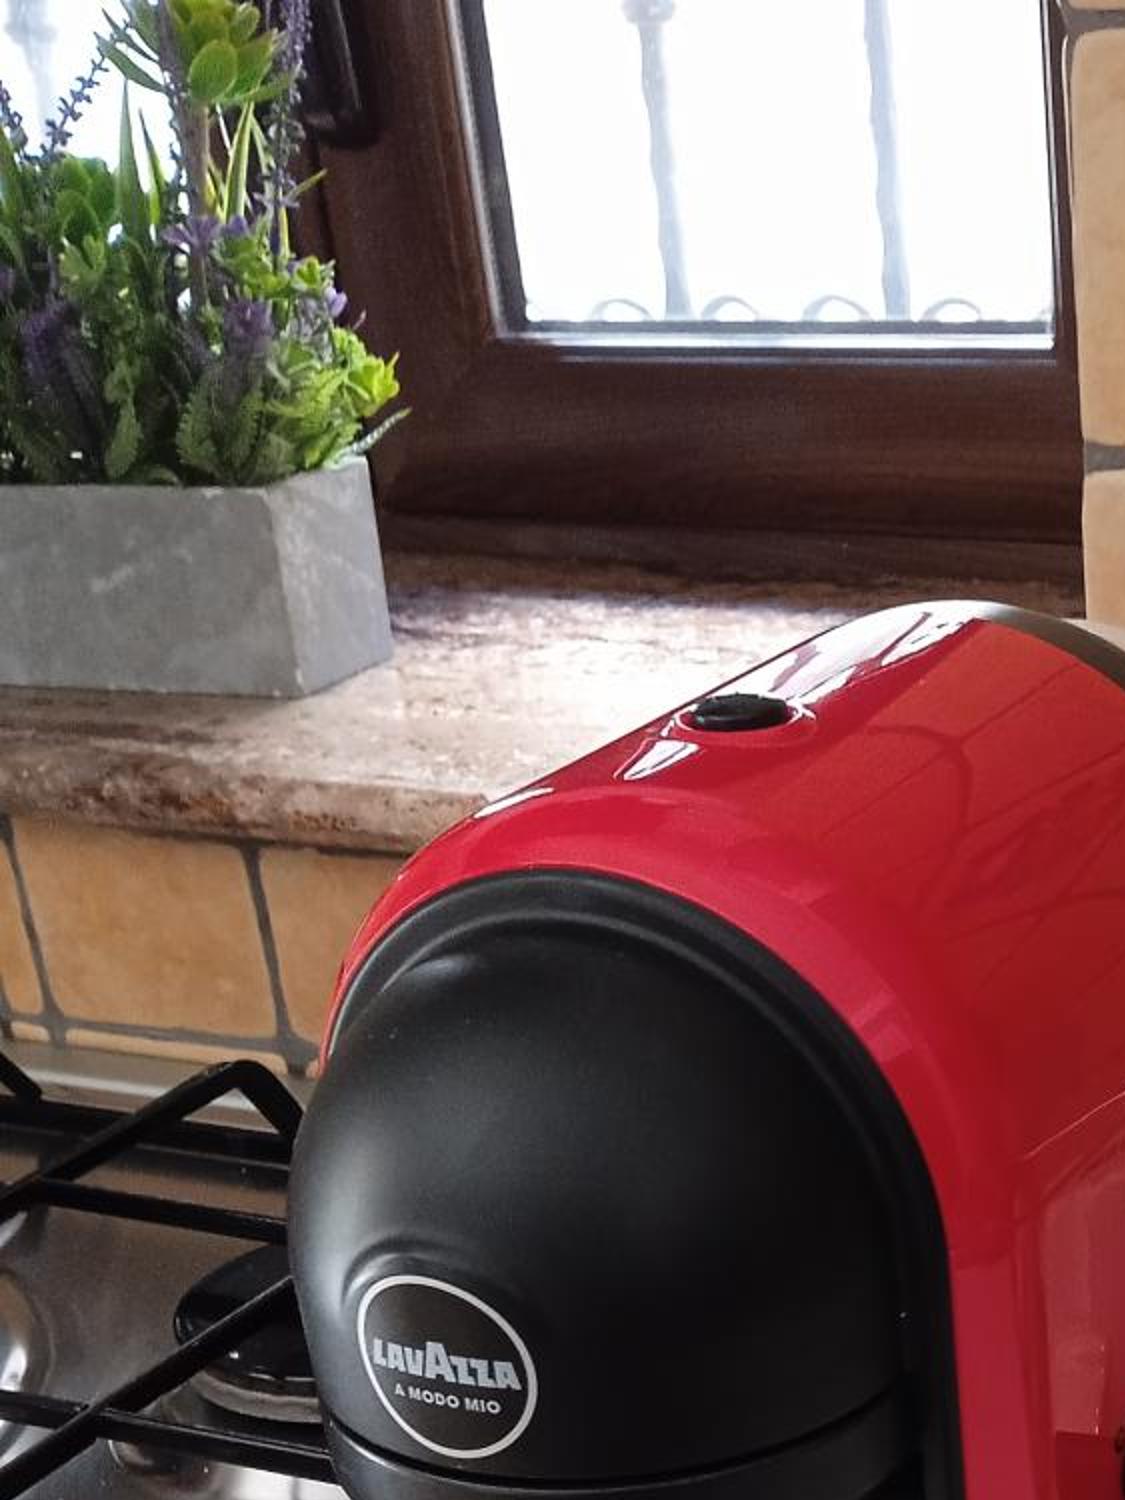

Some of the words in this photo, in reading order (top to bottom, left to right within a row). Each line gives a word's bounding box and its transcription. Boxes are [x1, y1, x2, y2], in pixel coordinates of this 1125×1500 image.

[372, 1336, 522, 1391] LAVAZZA
[394, 1383, 406, 1397] A
[408, 1387, 461, 1409] MODO
[465, 1396, 502, 1414] MIO
